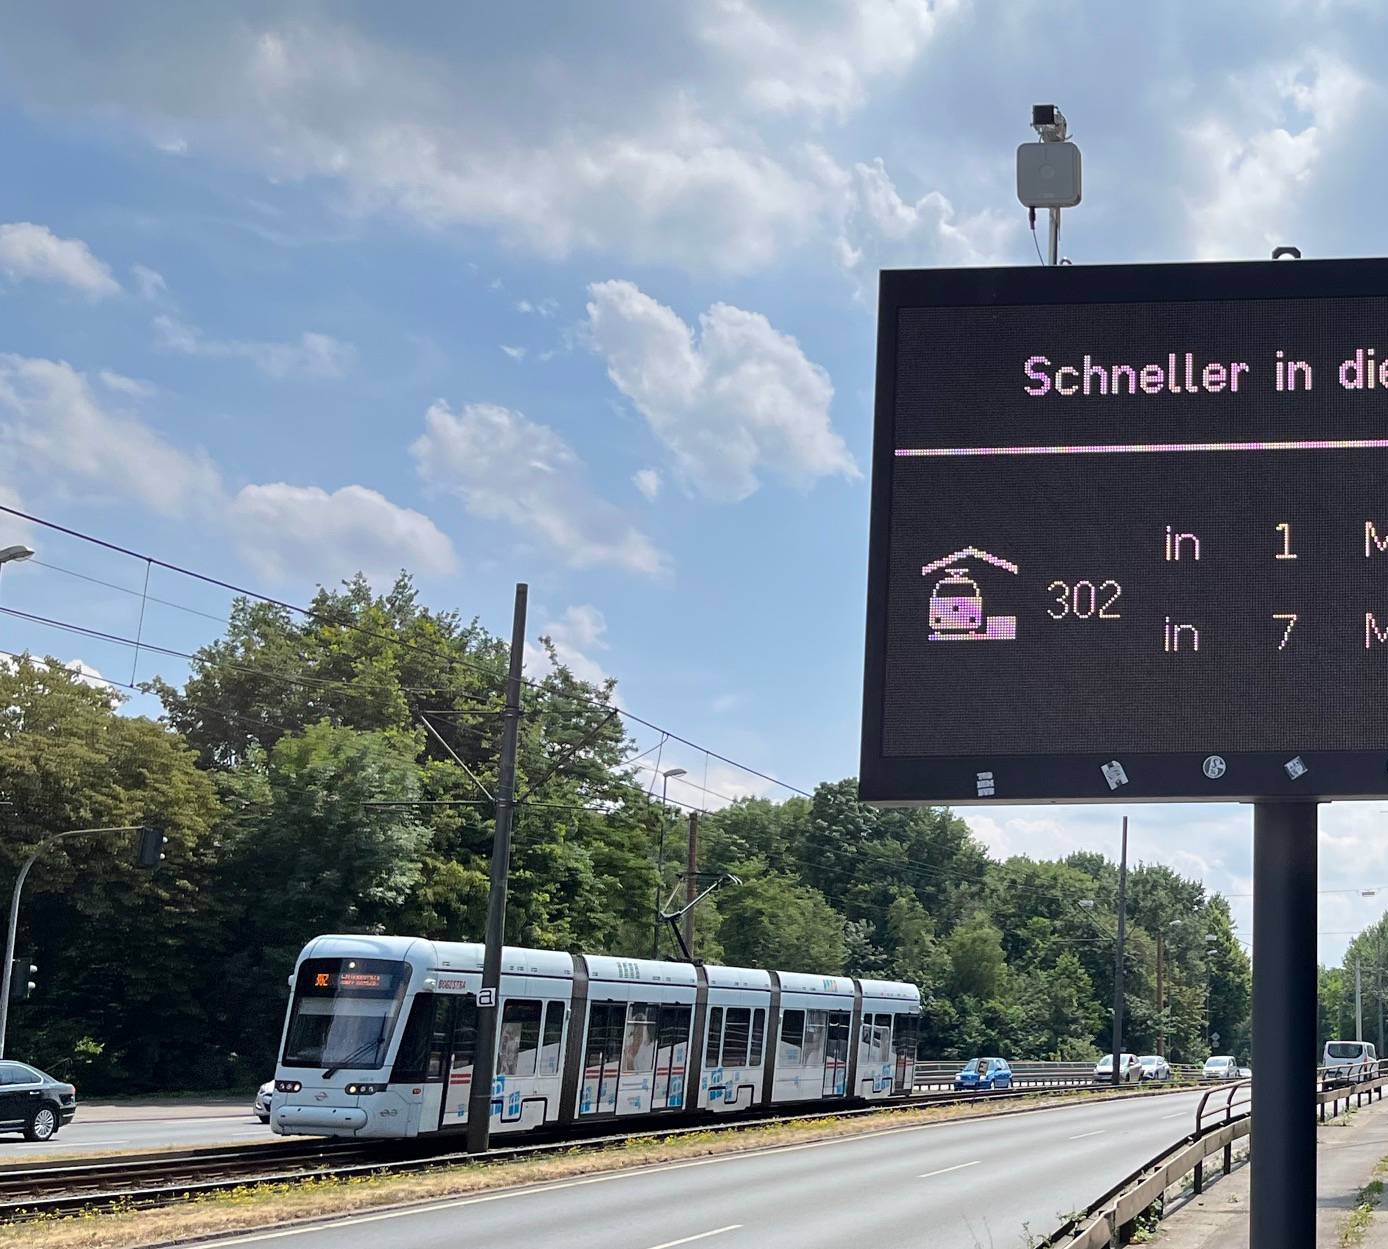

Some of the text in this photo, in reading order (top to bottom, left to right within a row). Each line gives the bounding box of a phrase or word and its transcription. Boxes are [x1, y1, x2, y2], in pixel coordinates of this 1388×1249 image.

[1023, 352, 1250, 396] Schneller
[1276, 350, 1312, 391] in
[1165, 525, 1200, 561] in
[1275, 523, 1298, 560] 1
[1046, 579, 1122, 620] 302
[1164, 616, 1199, 652] in
[1273, 613, 1297, 651] 7
